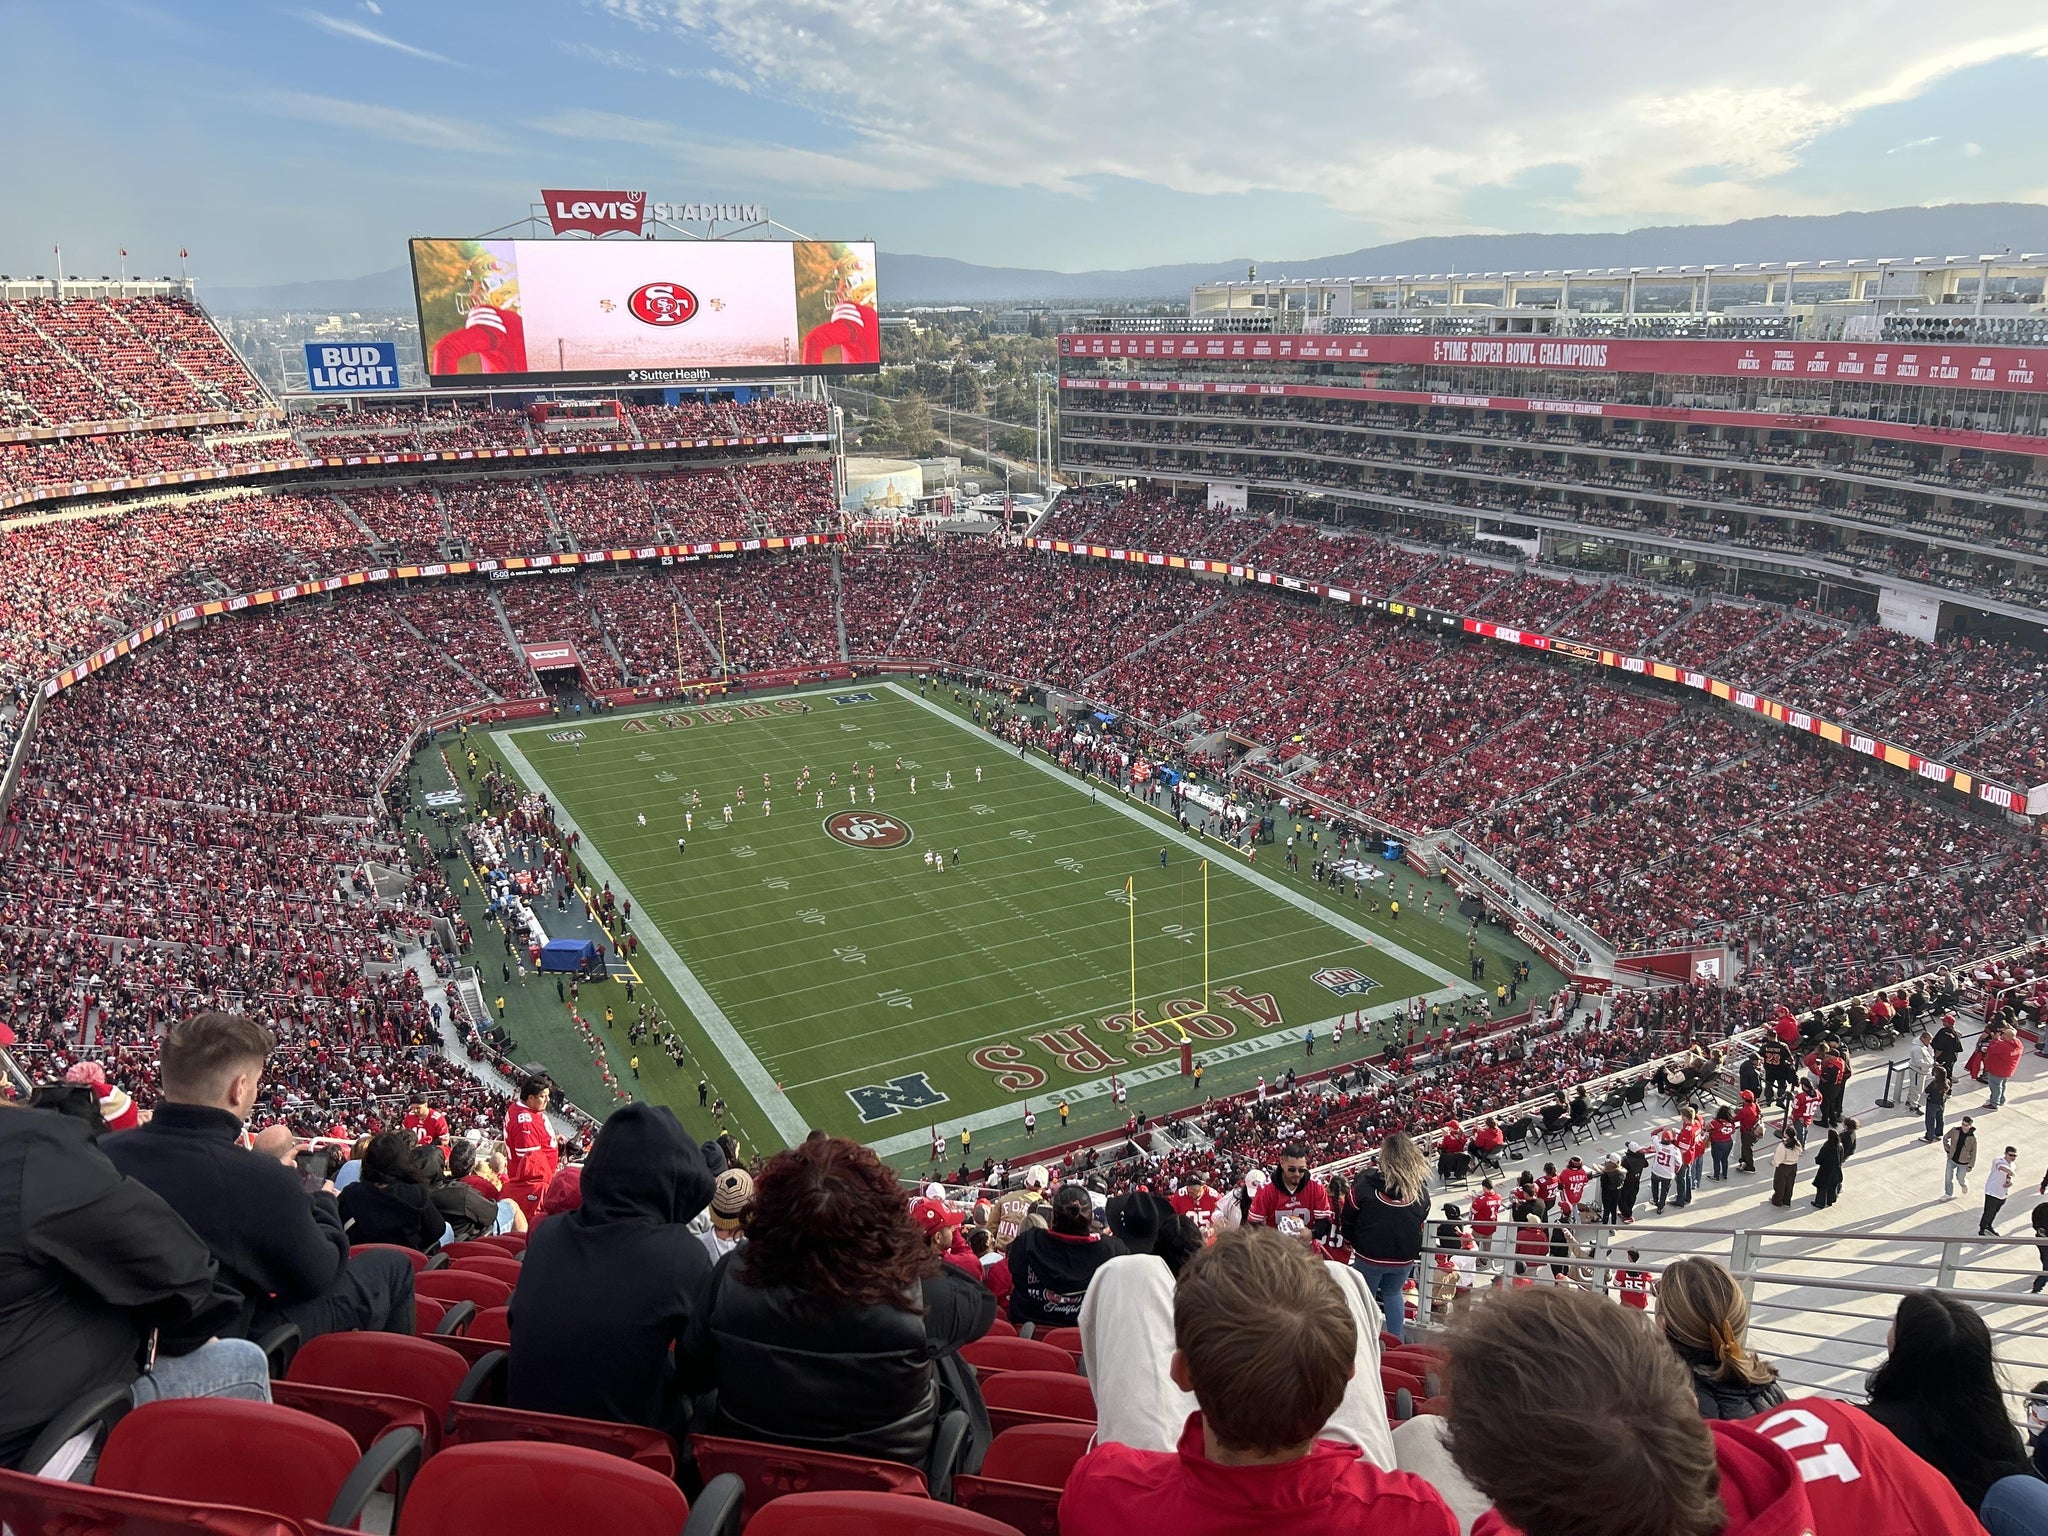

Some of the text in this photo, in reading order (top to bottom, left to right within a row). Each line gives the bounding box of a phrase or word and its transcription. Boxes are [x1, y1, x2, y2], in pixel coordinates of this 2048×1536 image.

[653, 203, 761, 221] STADIUM
[321, 347, 380, 367] BUD
[1434, 341, 1608, 367] 5-TIME SUPER BOWL CHAMPIONS
[1737, 359, 1760, 370] OWENS
[1771, 360, 1794, 371] OWENS
[1807, 361, 1829, 372] PERRY
[1929, 366, 1959, 379] ST. CLAIR
[313, 367, 393, 388] LIGHT
[640, 368, 710, 380] Sutter Health
[1970, 368, 1995, 381] TAYLOR
[2008, 370, 2034, 384] TITTLE
[548, 566, 575, 574] verizon
[1621, 656, 1644, 673] LOUD
[1684, 672, 1704, 688] LOUD
[1735, 691, 1755, 709] LOUD
[621, 699, 815, 733] 49ERS
[1789, 711, 1811, 731] LOUD
[1850, 734, 1875, 755] LOUD
[1919, 760, 1946, 782] LOUD
[1981, 783, 2011, 807] LOUD
[730, 847, 757, 858] 50
[796, 908, 825, 923] 30
[1514, 923, 1545, 954] Faithful
[833, 945, 866, 962] 20
[1316, 969, 1362, 986] NFL
[877, 988, 912, 1007] 10
[966, 985, 1285, 1093] 49ERS
[1279, 1030, 1302, 1044] IT
[1193, 1040, 1271, 1066] TAKES
[1132, 1061, 1180, 1080] ALL
[1046, 1089, 1084, 1105] US
[1656, 1152, 1671, 1166] 21
